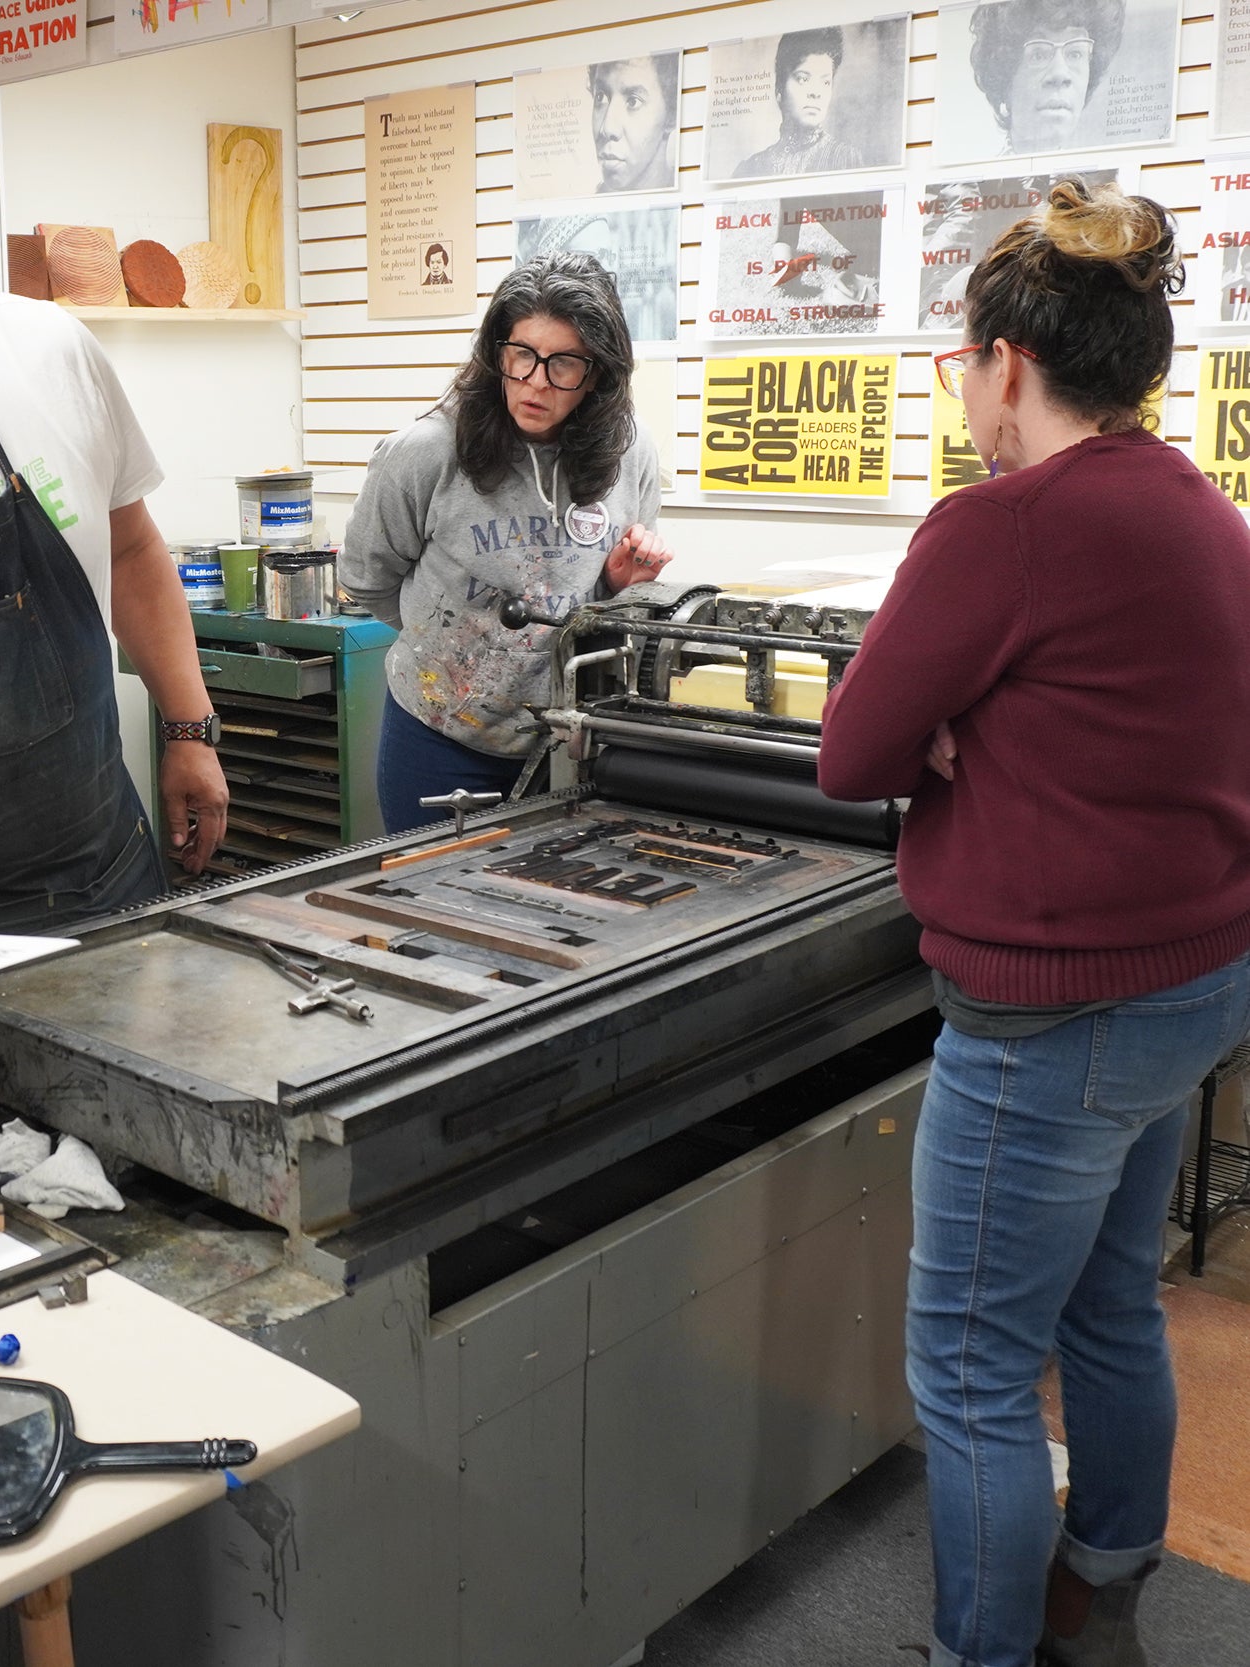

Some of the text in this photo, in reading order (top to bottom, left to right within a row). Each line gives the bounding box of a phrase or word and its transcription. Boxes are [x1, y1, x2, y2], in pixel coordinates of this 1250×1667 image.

[715, 70, 771, 84] The way right
[713, 83, 771, 96] wrongs turn
[713, 93, 770, 106] the light truth
[712, 107, 753, 119] upon them.
[380, 106, 454, 137] Truth may withstand
[424, 123, 437, 132] love
[439, 122, 452, 132] may
[380, 142, 409, 152] overcome
[380, 147, 455, 167] opinion may opposed
[431, 162, 451, 173] theory
[389, 180, 423, 191] liberty may
[380, 194, 404, 207] opposed
[918, 191, 1042, 216] WE SHOULD
[380, 209, 393, 218] and
[394, 207, 420, 216] common
[716, 204, 887, 230] BLACK LIBERATION
[380, 217, 434, 231] alike teaches that
[380, 231, 436, 246] physical resistance
[380, 246, 417, 256] the antidote
[922, 248, 971, 266] WITH
[391, 258, 416, 271] physical
[747, 255, 857, 275] IS PART OF
[709, 303, 886, 323] GLOBAL STRUGGLE
[757, 360, 858, 413] BLACK
[705, 367, 754, 486] A CALL
[801, 422, 857, 433] LEADERS
[859, 365, 890, 483] THE PEOPLE
[751, 418, 799, 484] FOR
[799, 439, 857, 450] WHO CAN
[803, 455, 850, 482] HEAR
